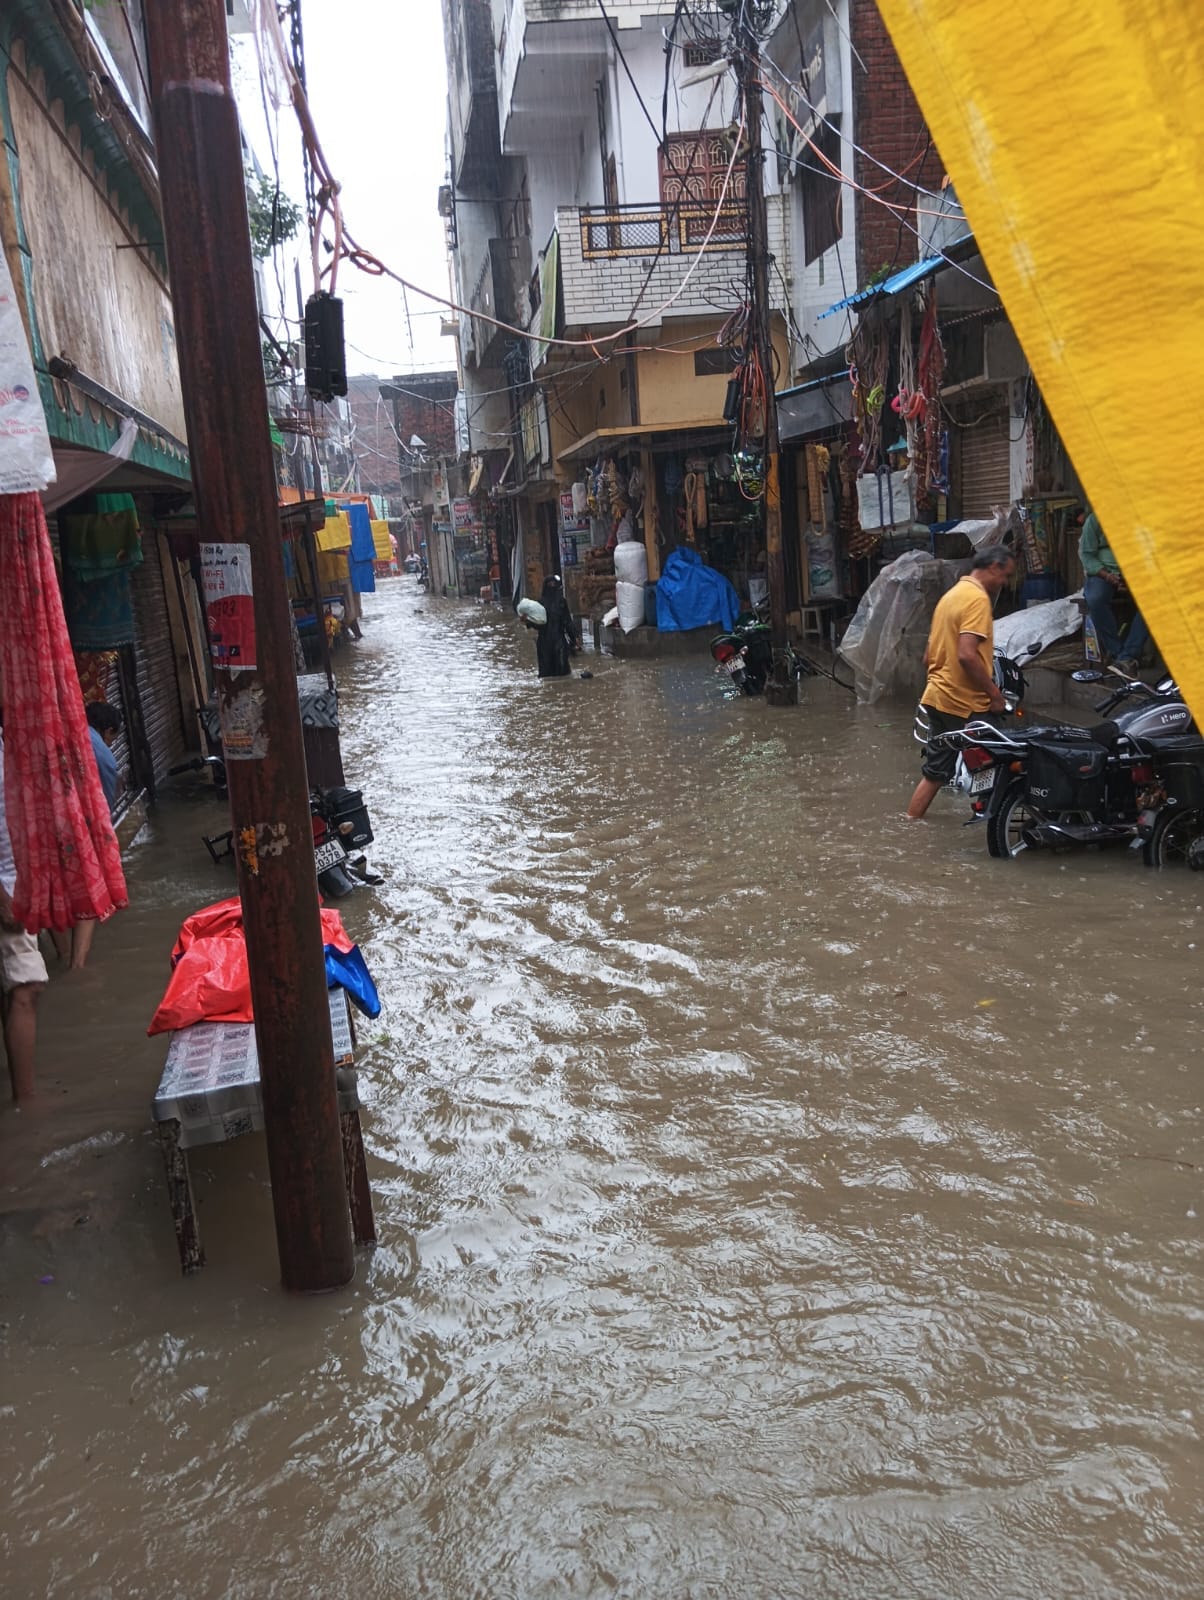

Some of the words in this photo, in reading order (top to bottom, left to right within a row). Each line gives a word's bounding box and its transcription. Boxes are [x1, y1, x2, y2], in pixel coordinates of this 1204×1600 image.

[1169, 712, 1187, 721] Hero
[314, 842, 337, 860] P54A
[316, 850, 341, 869] 0378
